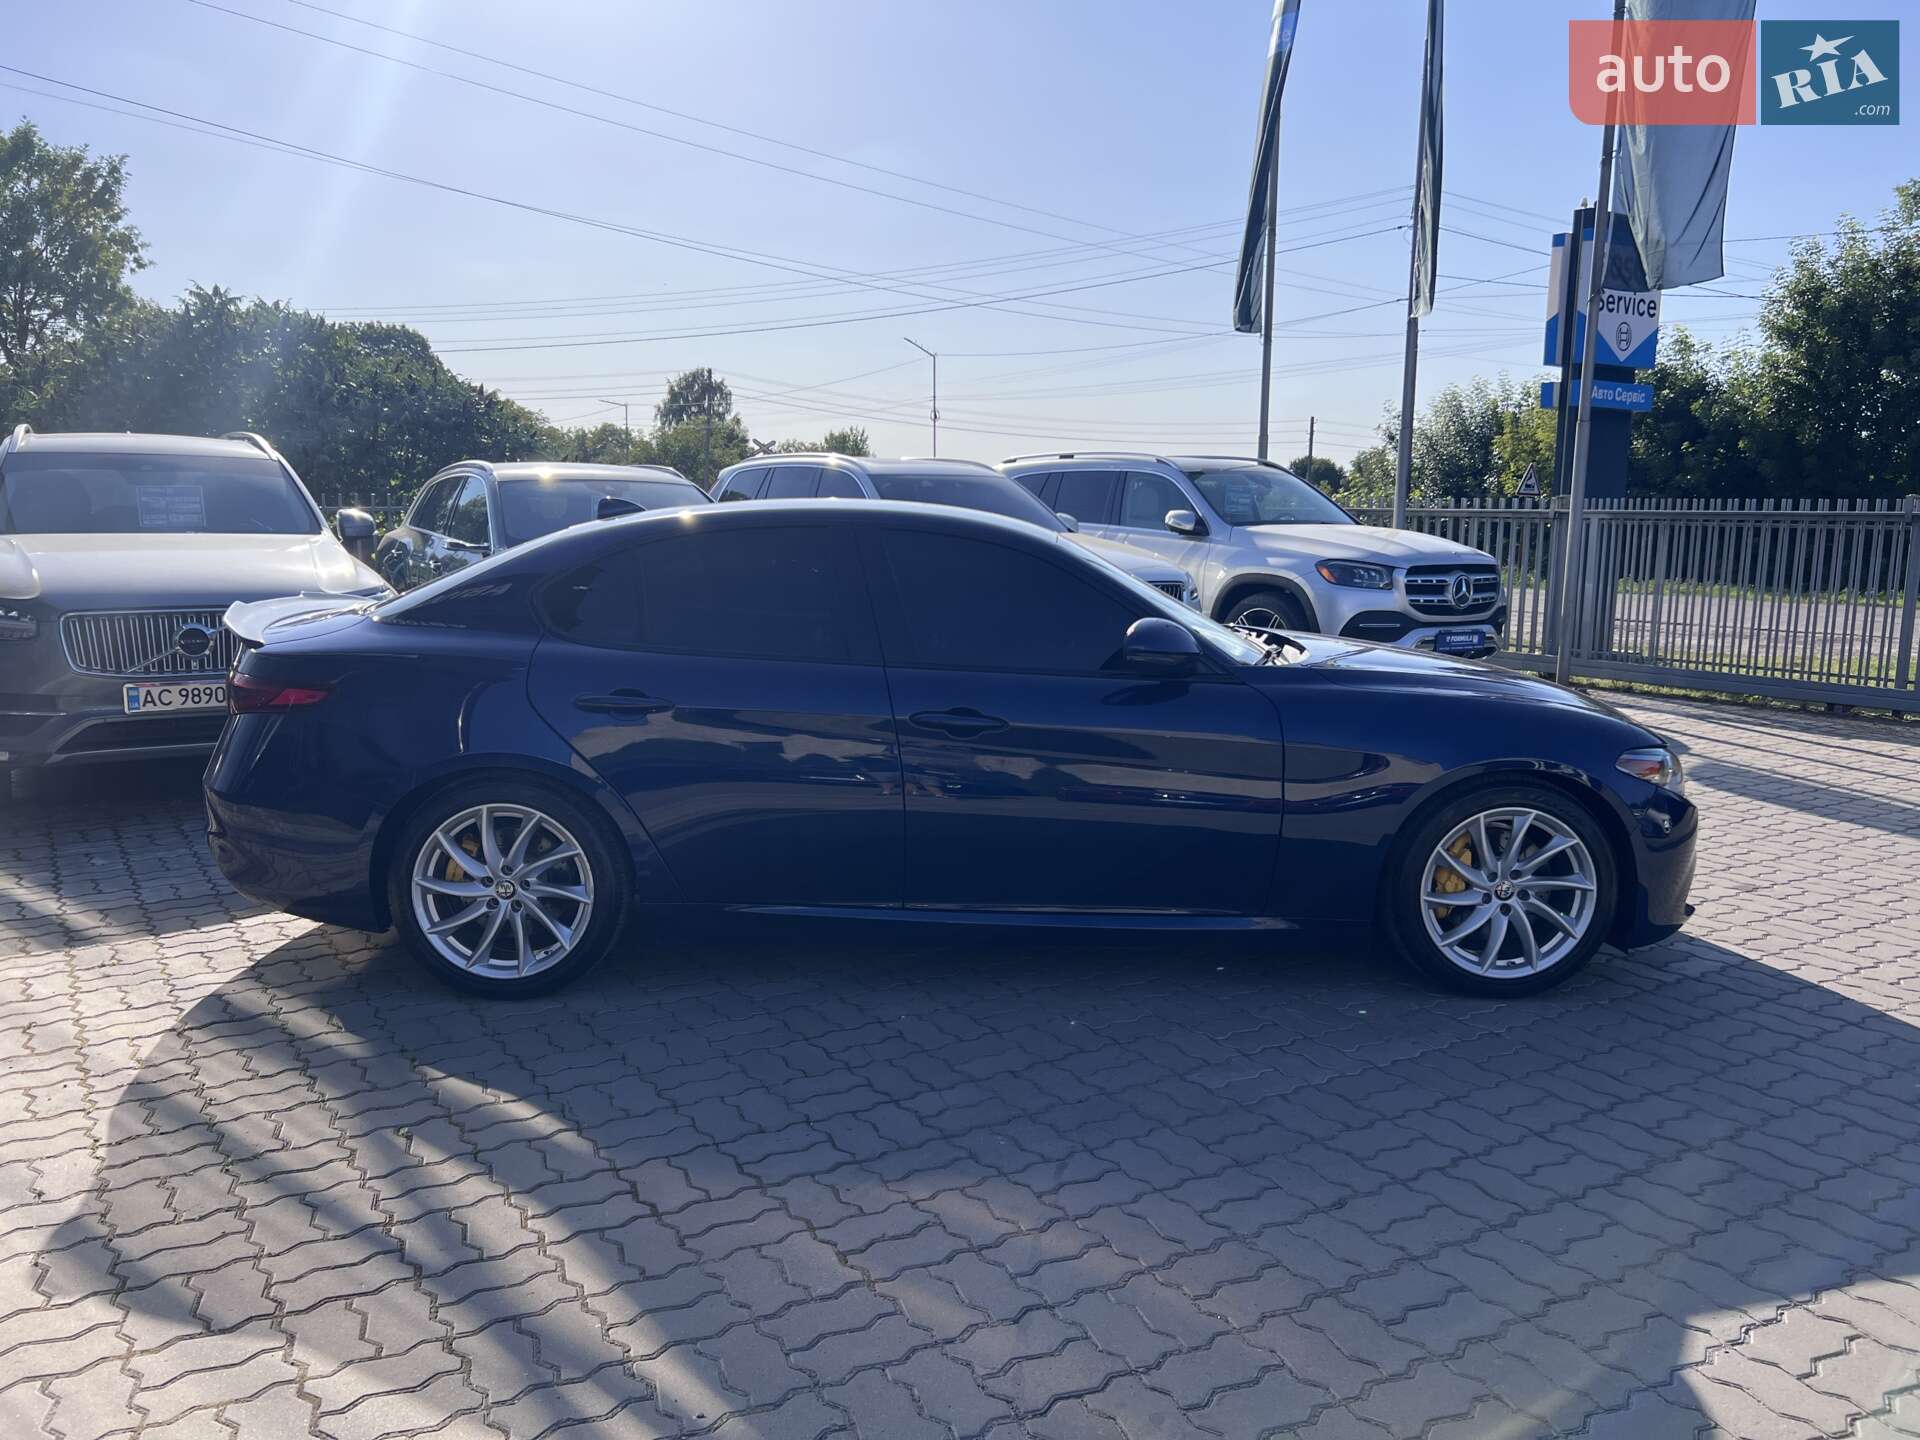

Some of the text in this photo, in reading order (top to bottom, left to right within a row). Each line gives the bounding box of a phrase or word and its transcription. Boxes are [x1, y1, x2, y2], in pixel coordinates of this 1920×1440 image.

[1591, 385, 1614, 401] Авто
[142, 687, 225, 707] AC 9890
